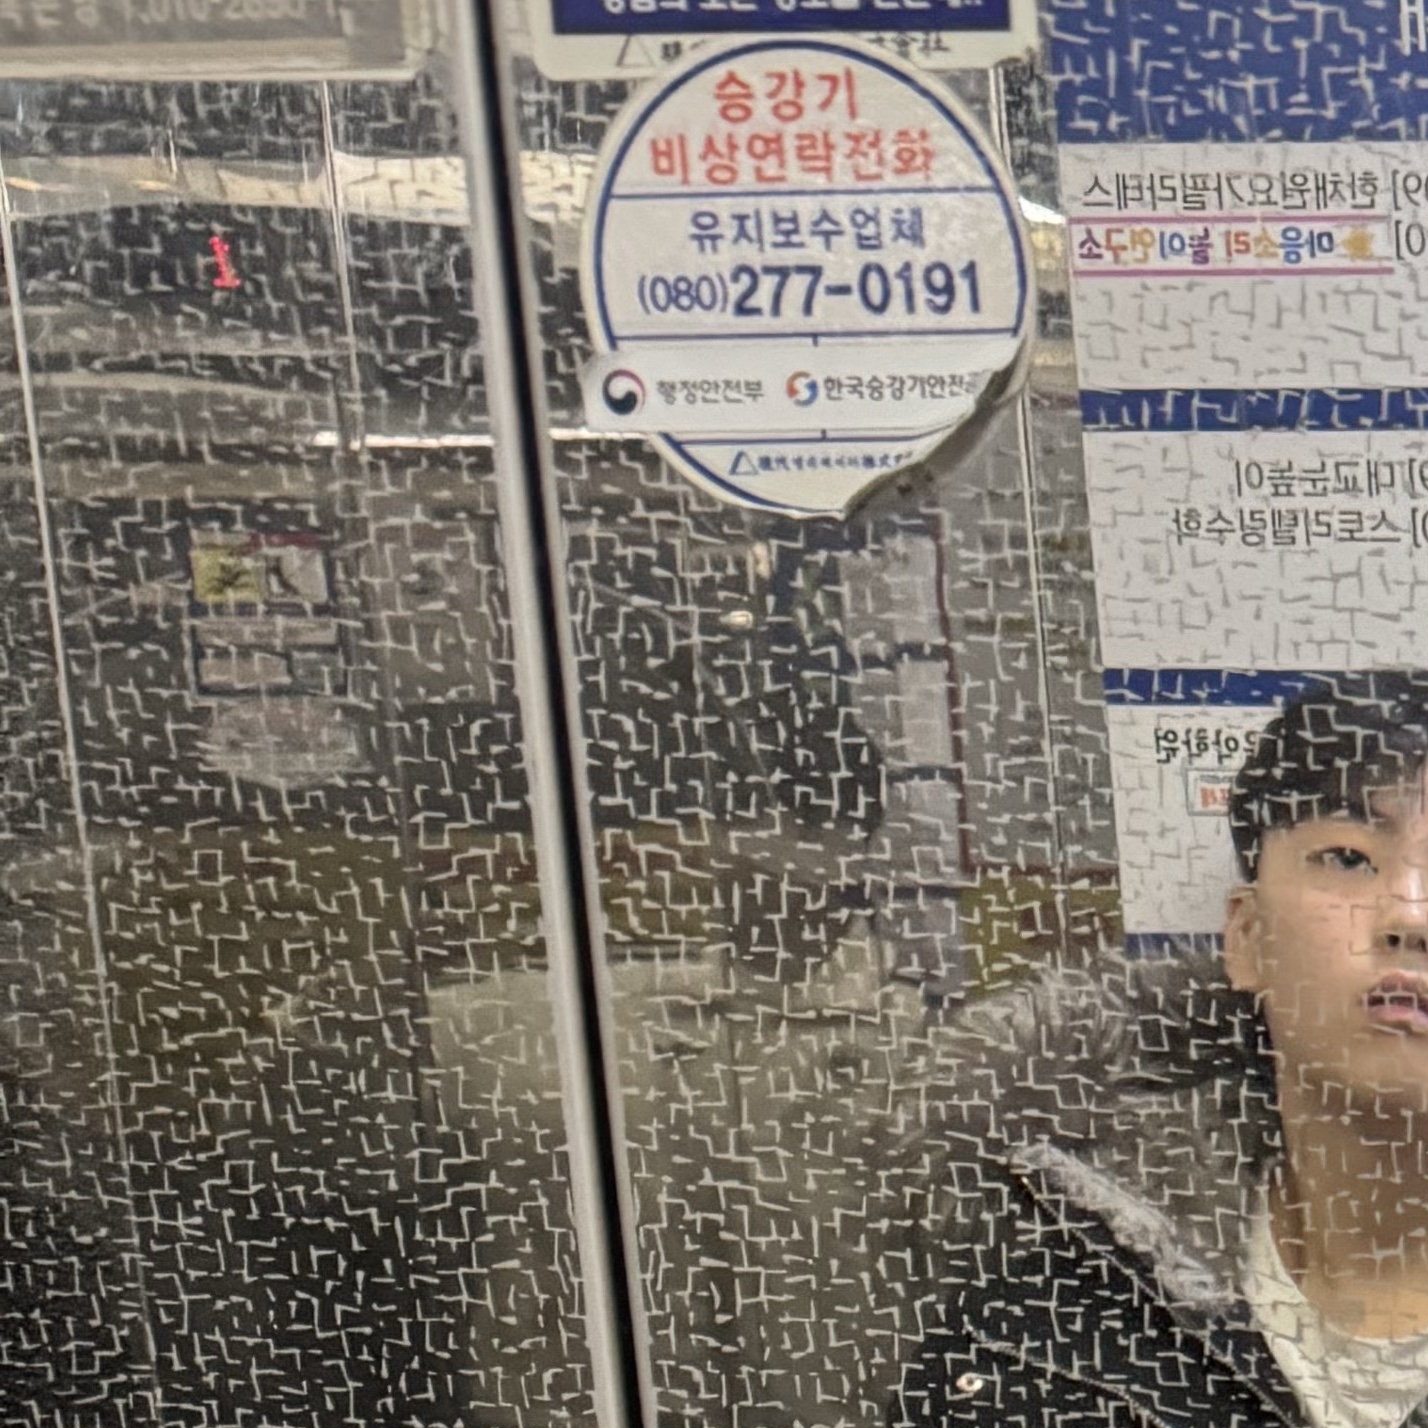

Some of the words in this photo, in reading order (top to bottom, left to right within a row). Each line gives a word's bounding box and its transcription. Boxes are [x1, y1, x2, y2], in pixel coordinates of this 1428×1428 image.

[714, 68, 859, 121] 승강기
[650, 130, 937, 184] 비상연락전화
[689, 207, 926, 251] 유지보수업체
[637, 261, 982, 317] (080)277-0191
[656, 379, 765, 404] 행정안전부
